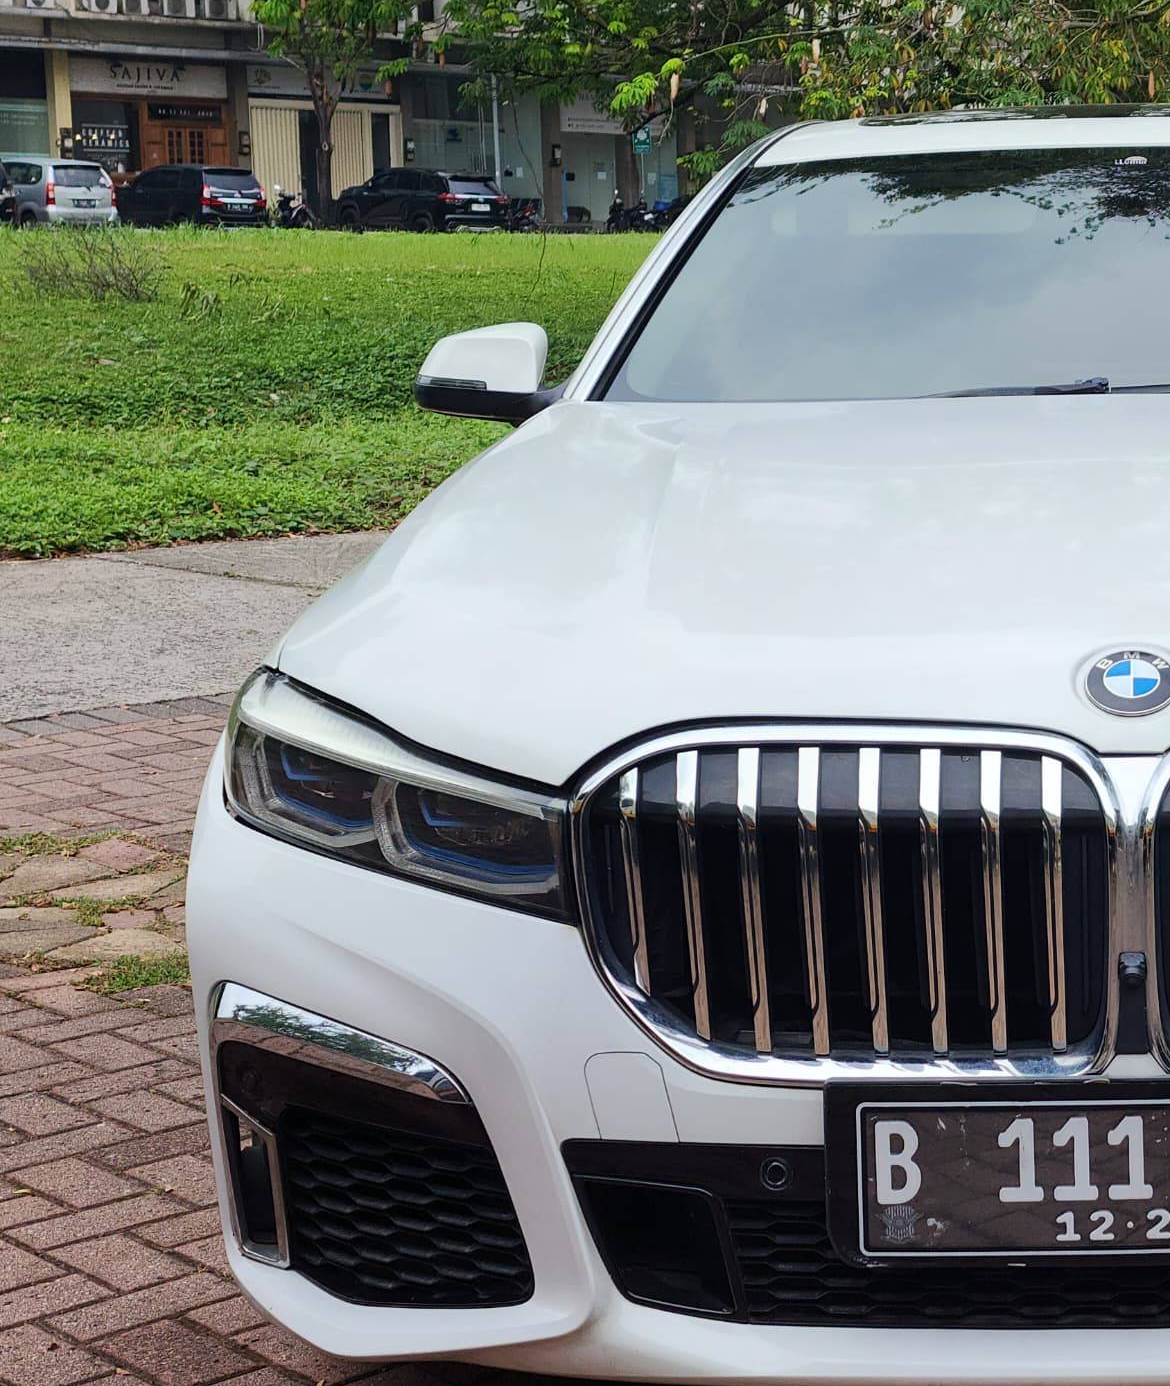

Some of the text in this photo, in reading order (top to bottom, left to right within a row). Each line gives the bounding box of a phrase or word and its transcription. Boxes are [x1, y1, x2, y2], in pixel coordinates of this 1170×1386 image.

[110, 65, 180, 82] SAJIVA
[1096, 652, 1169, 670] BMW
[875, 1120, 921, 1205] B
[998, 1115, 1154, 1203] 111
